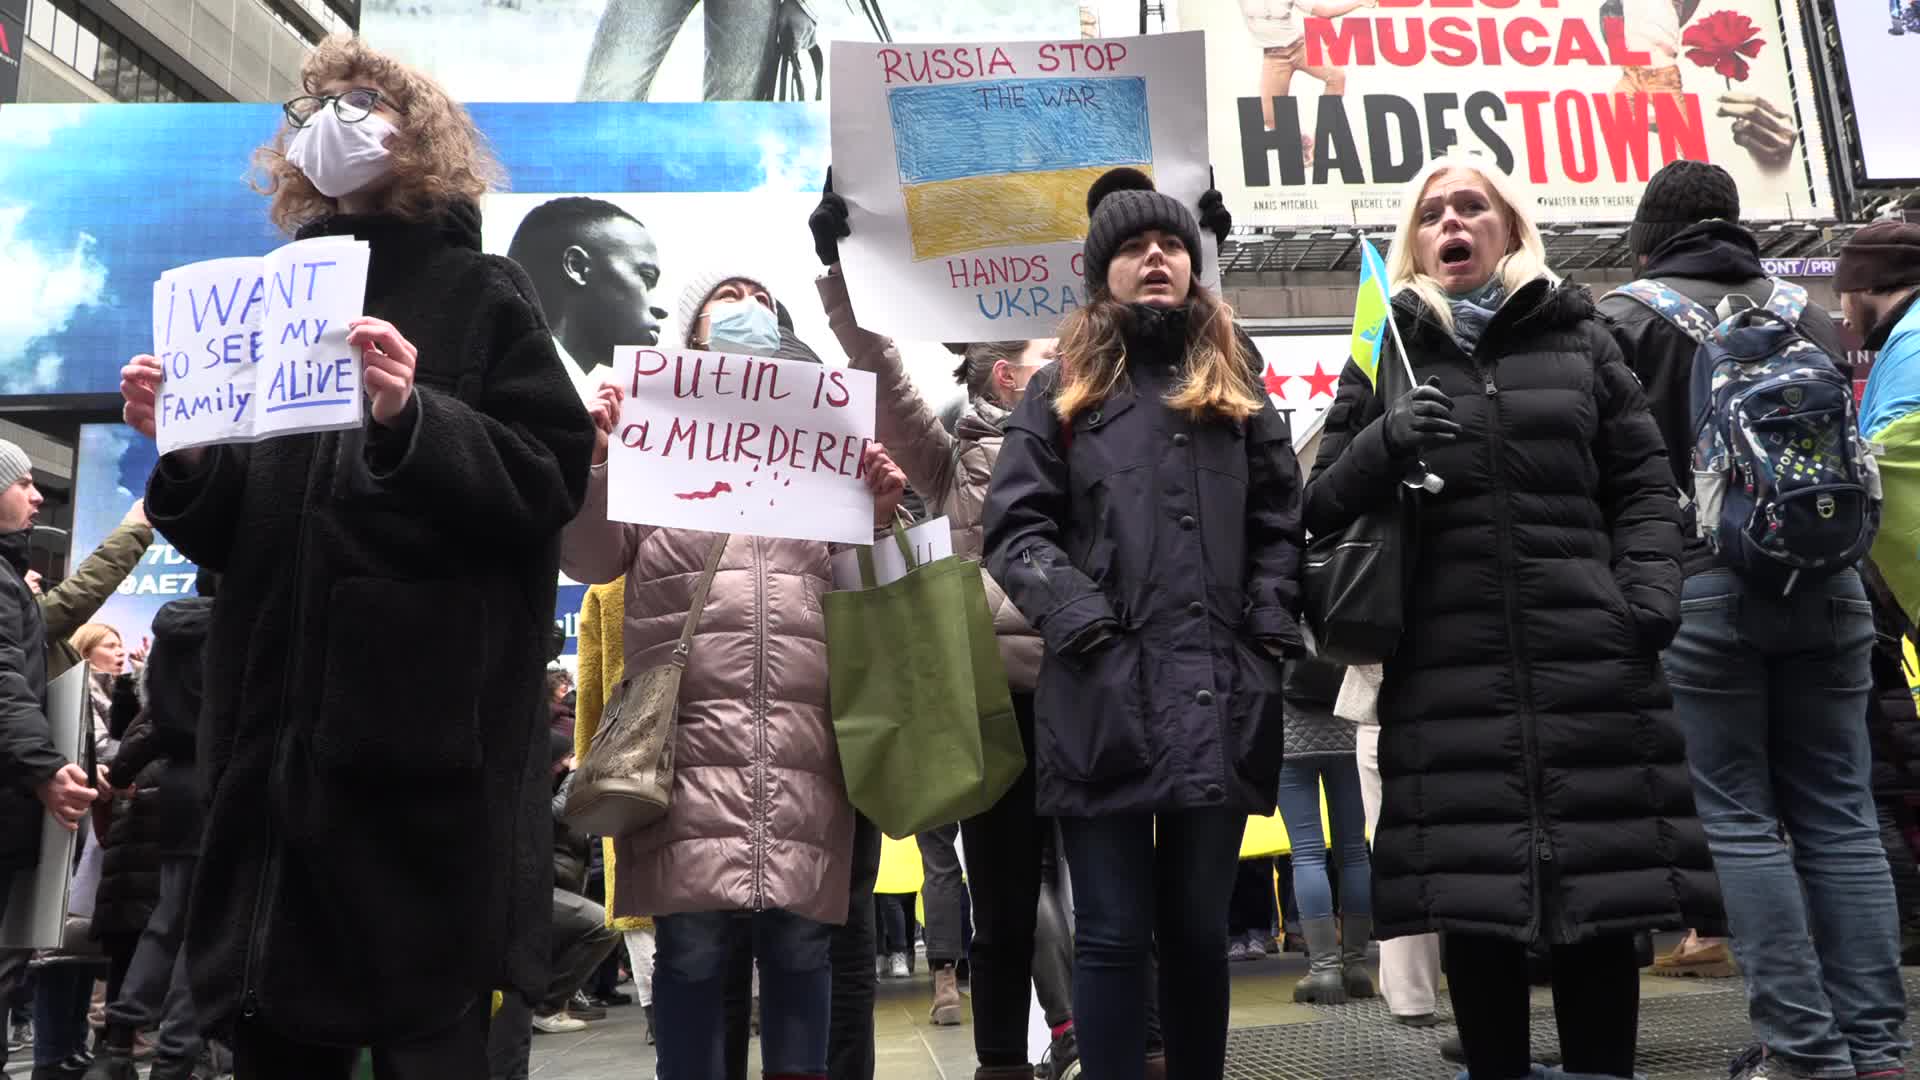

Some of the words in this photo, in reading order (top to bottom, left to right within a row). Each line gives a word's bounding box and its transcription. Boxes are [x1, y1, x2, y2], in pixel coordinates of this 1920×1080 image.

[877, 47, 1017, 84] RUSSIA
[1038, 42, 1127, 73] STOP
[1303, 16, 1651, 67] MUSICAL
[975, 86, 1025, 111] THE
[1040, 86, 1101, 110] WAR
[1236, 89, 1710, 187] HADESTOWN
[947, 254, 1049, 289] HANDS
[189, 261, 337, 333] WANT
[976, 285, 1079, 320] UKRA
[161, 351, 190, 383] TO
[203, 331, 264, 369] SEE
[280, 319, 328, 347] MY
